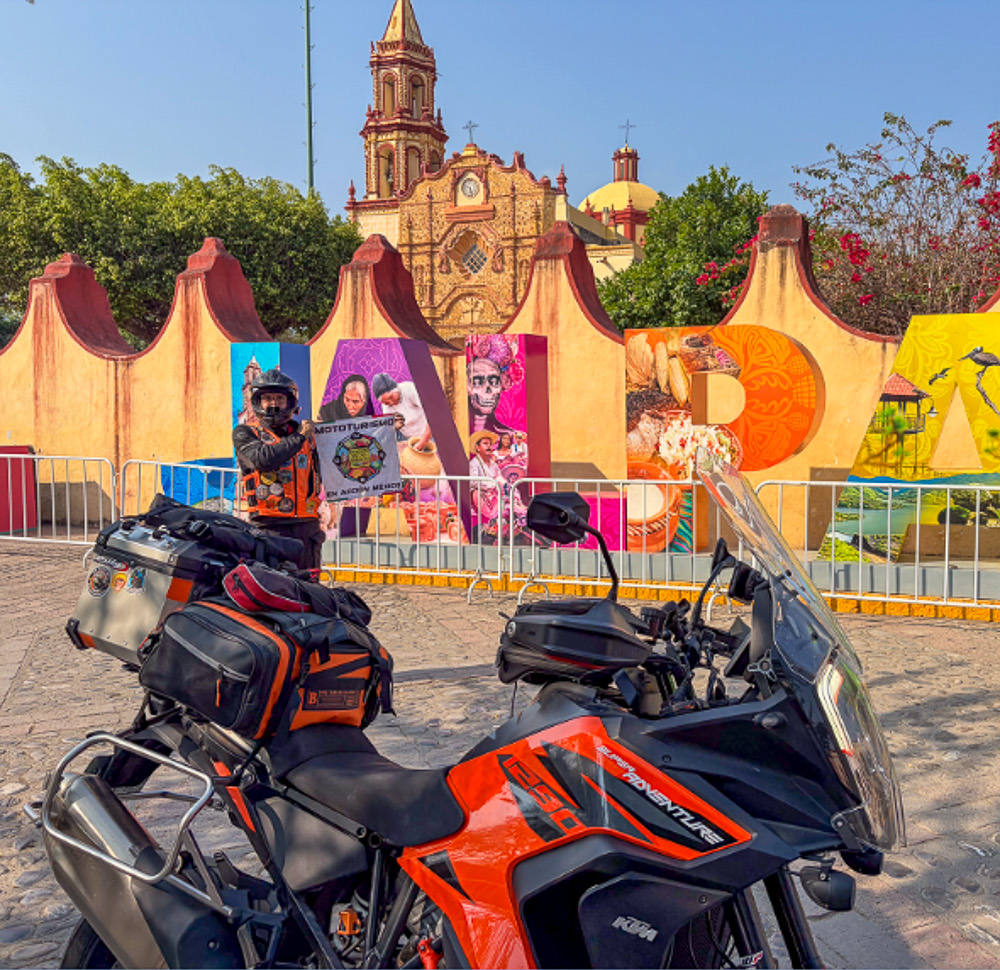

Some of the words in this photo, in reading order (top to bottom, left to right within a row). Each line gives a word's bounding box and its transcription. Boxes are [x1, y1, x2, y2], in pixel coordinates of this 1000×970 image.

[315, 418, 394, 434] MOTOTURISMO
[502, 755, 587, 837] 1290
[596, 744, 636, 772] SUPER
[622, 772, 724, 846] ADVENTURE
[611, 916, 658, 942] KTM
